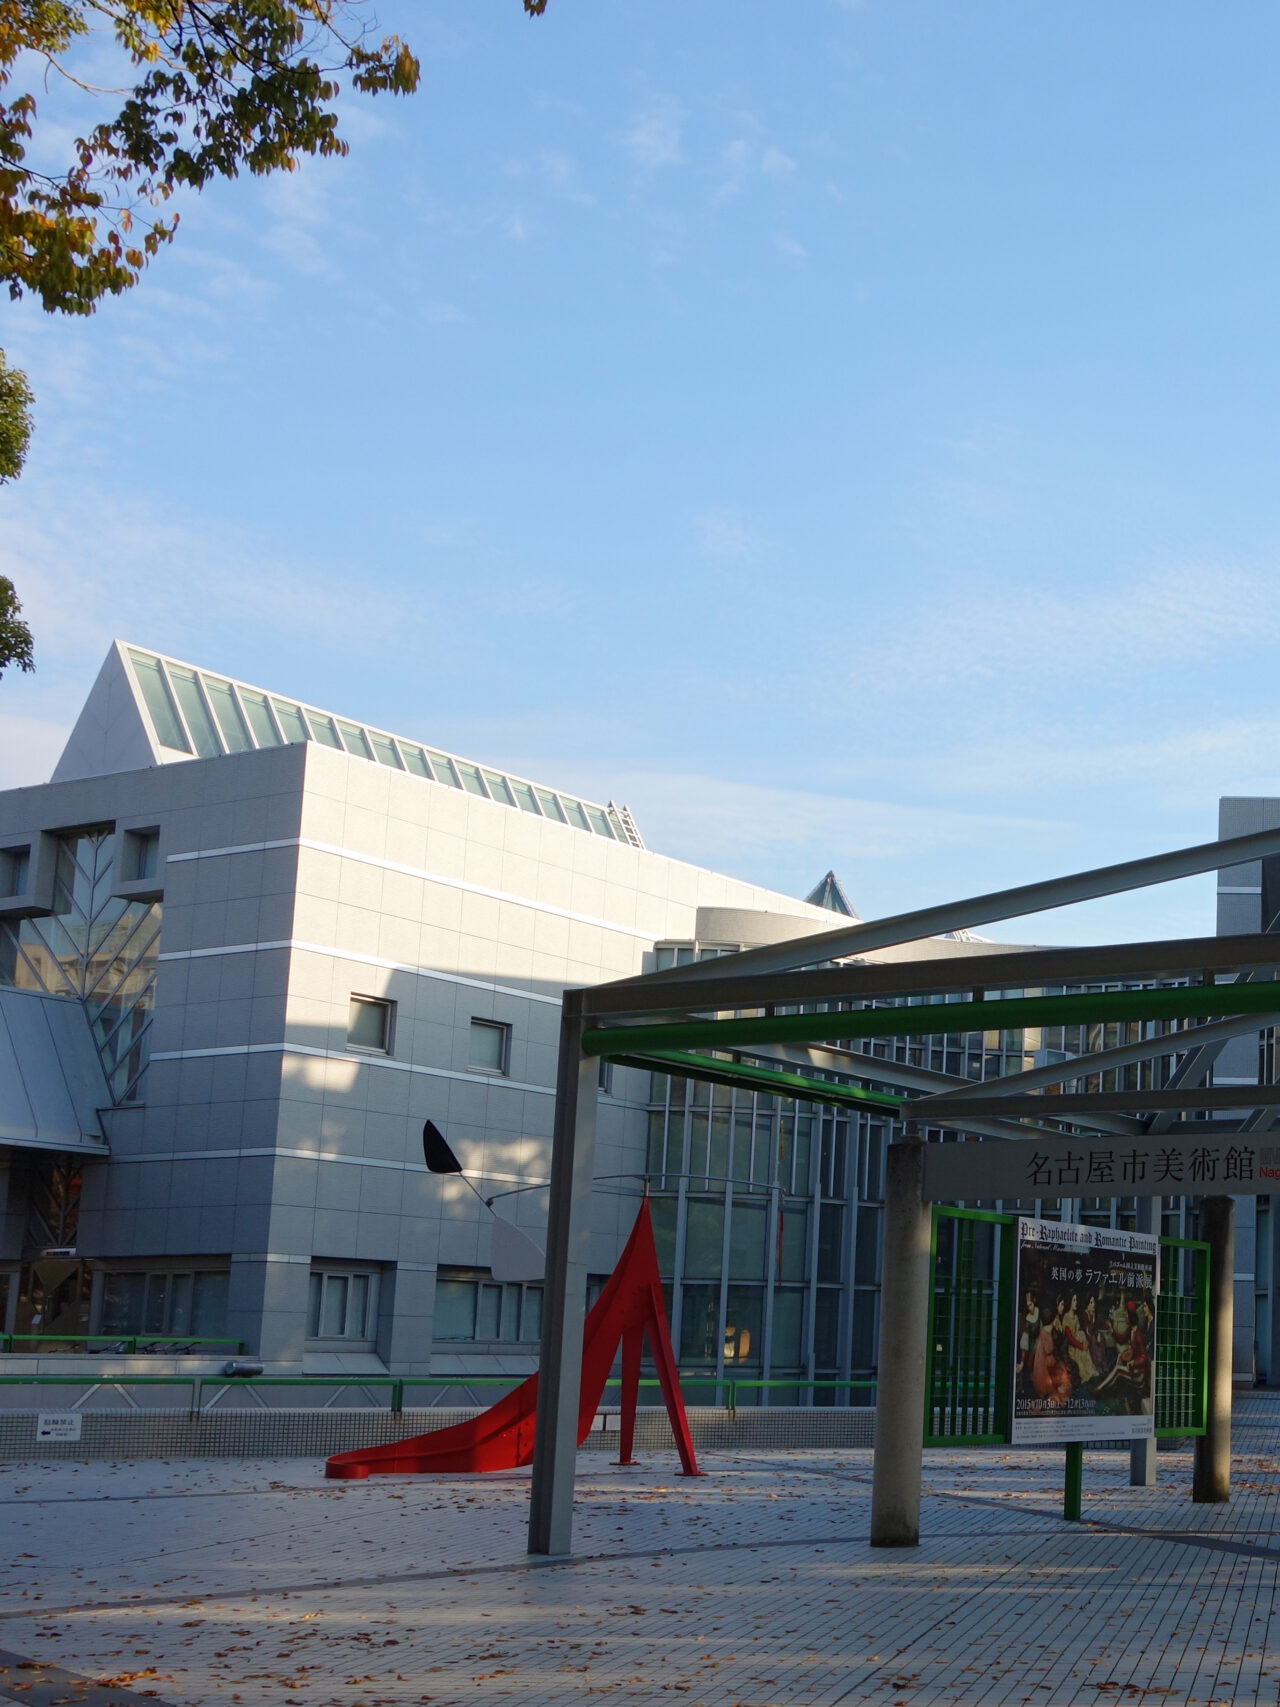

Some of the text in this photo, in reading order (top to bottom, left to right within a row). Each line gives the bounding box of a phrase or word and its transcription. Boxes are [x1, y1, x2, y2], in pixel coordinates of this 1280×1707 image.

[1025, 1147, 1256, 1186] 名古屋市美術館
[1021, 1222, 1078, 1243] Pre-Raphaelite
[1079, 1231, 1092, 1243] and
[1095, 1231, 1127, 1248] Romantic
[1129, 1236, 1157, 1254] Painting
